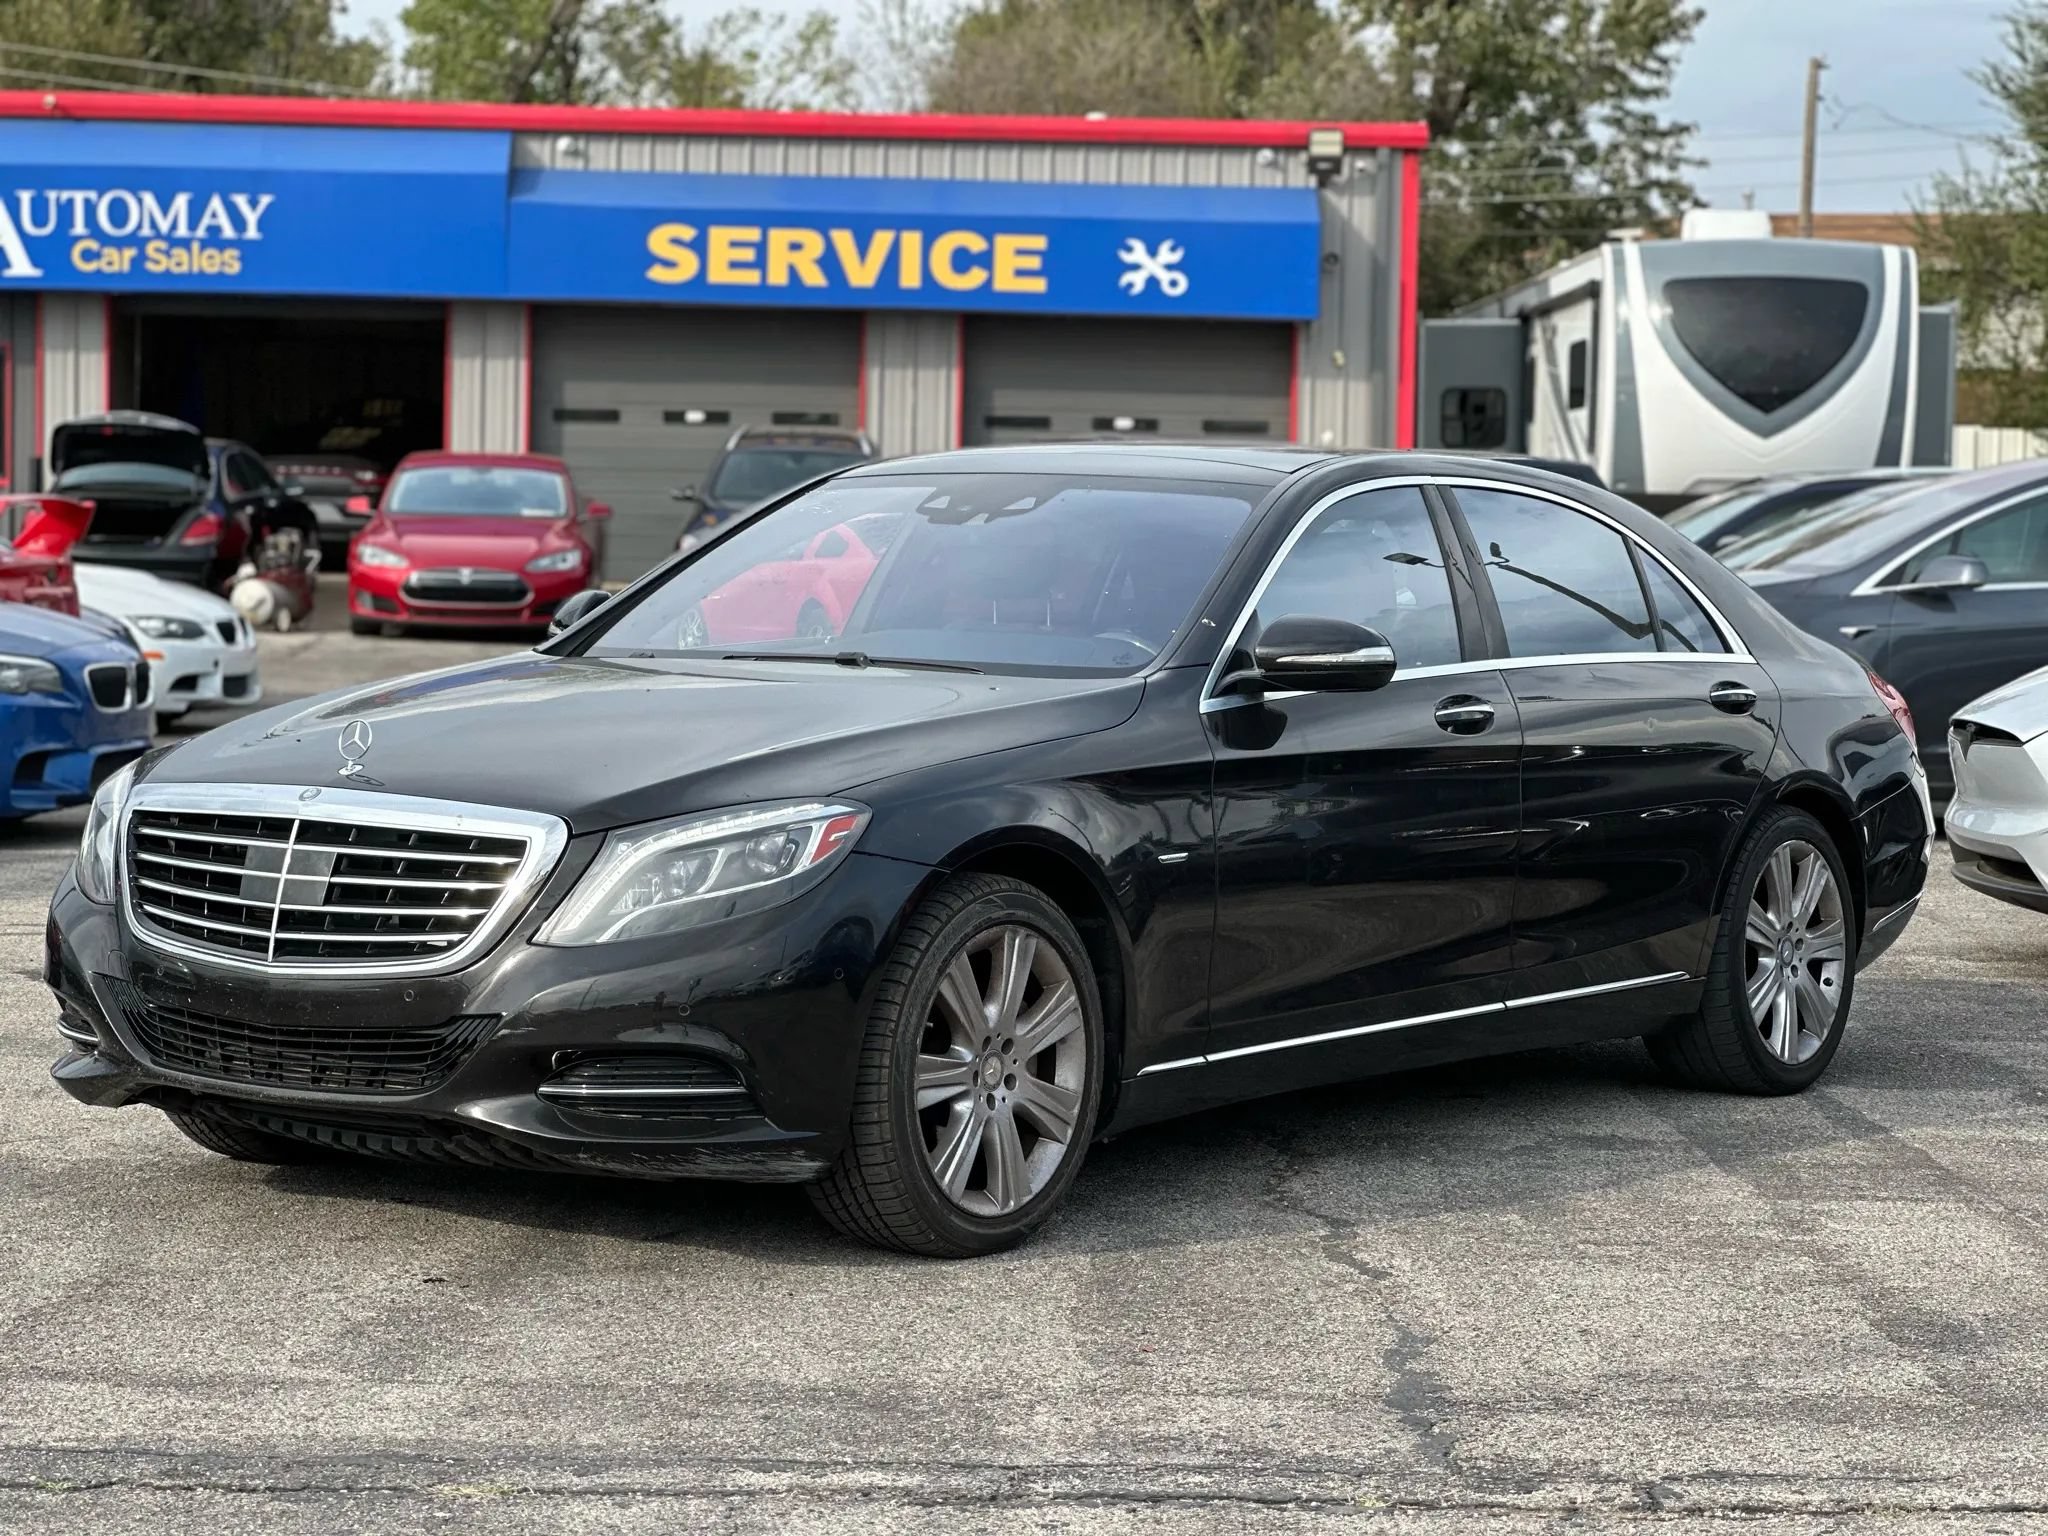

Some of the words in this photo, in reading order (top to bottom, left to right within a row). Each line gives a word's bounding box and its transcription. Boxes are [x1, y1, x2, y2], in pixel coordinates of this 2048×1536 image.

[70, 238, 137, 273] Car
[144, 239, 242, 275] Sales
[645, 223, 1048, 293] SERVICE
